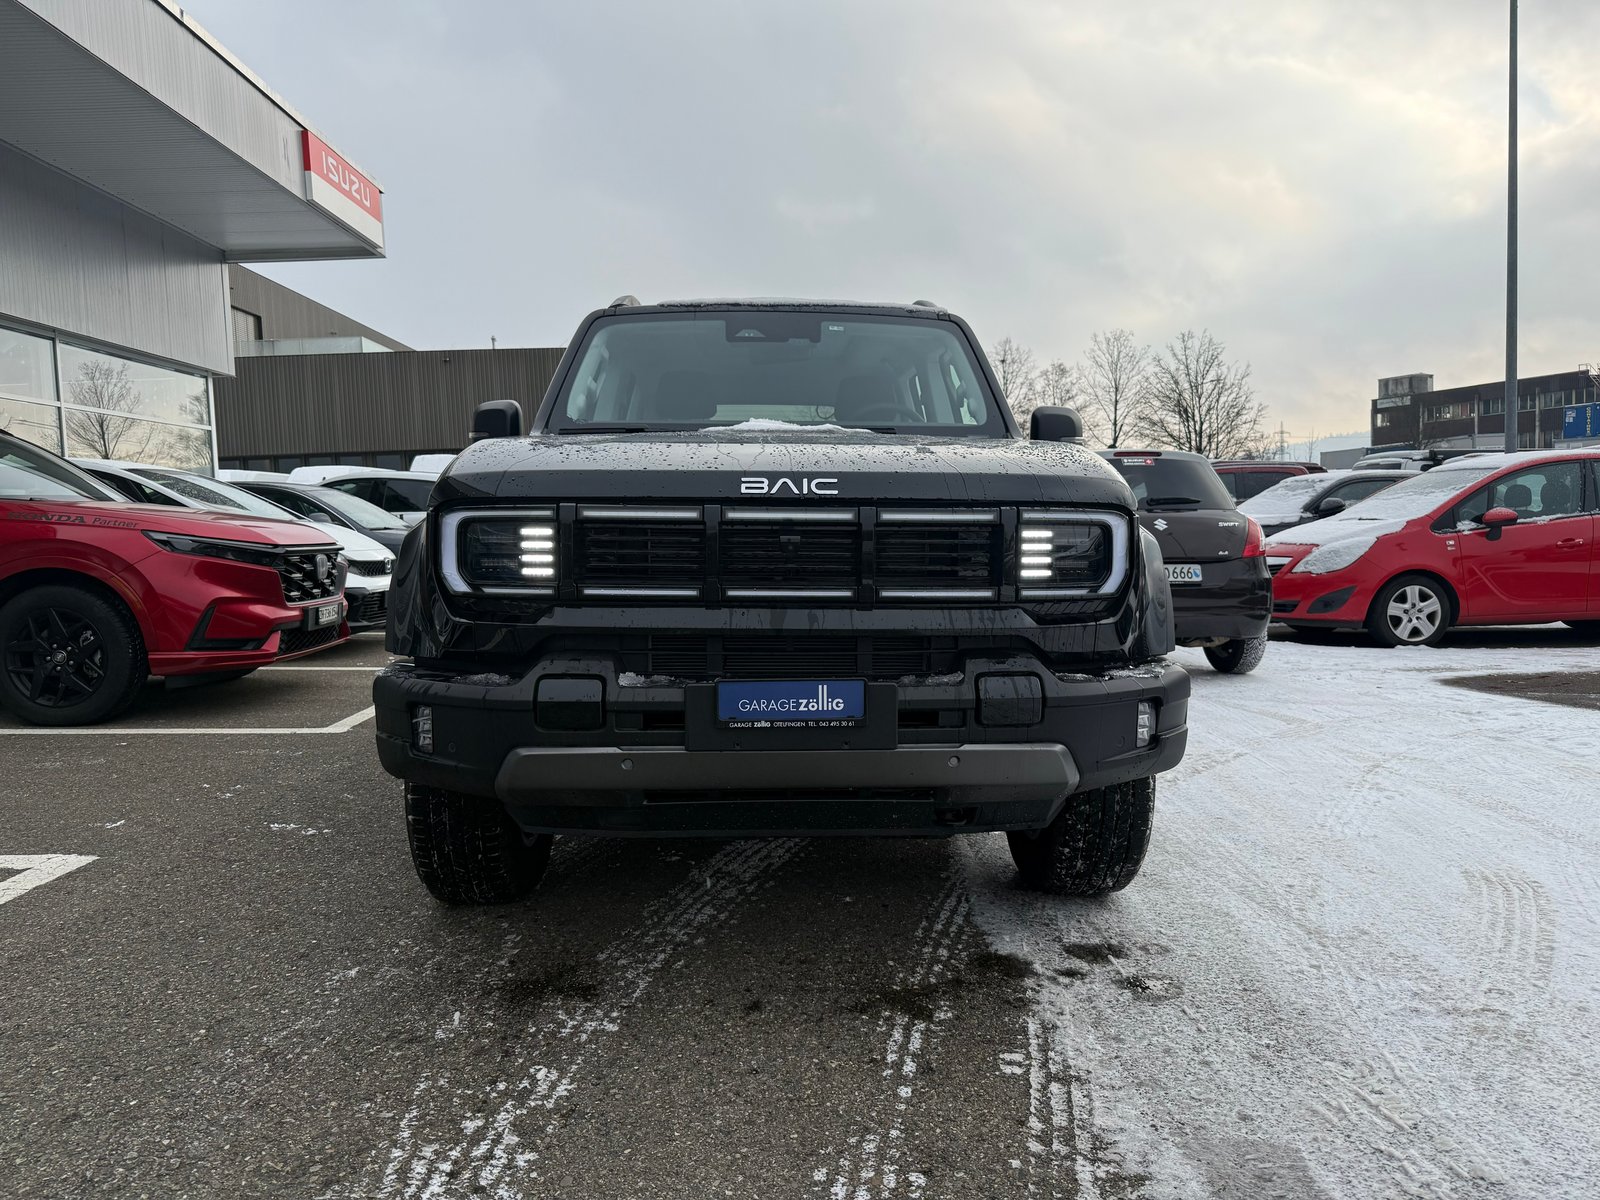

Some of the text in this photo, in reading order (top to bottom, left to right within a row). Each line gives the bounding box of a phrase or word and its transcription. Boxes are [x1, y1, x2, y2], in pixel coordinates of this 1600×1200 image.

[321, 150, 371, 208] ISUZU
[741, 477, 839, 495] BAIC
[7, 511, 139, 529] HONDA Partner
[738, 699, 797, 712] GARAGE
